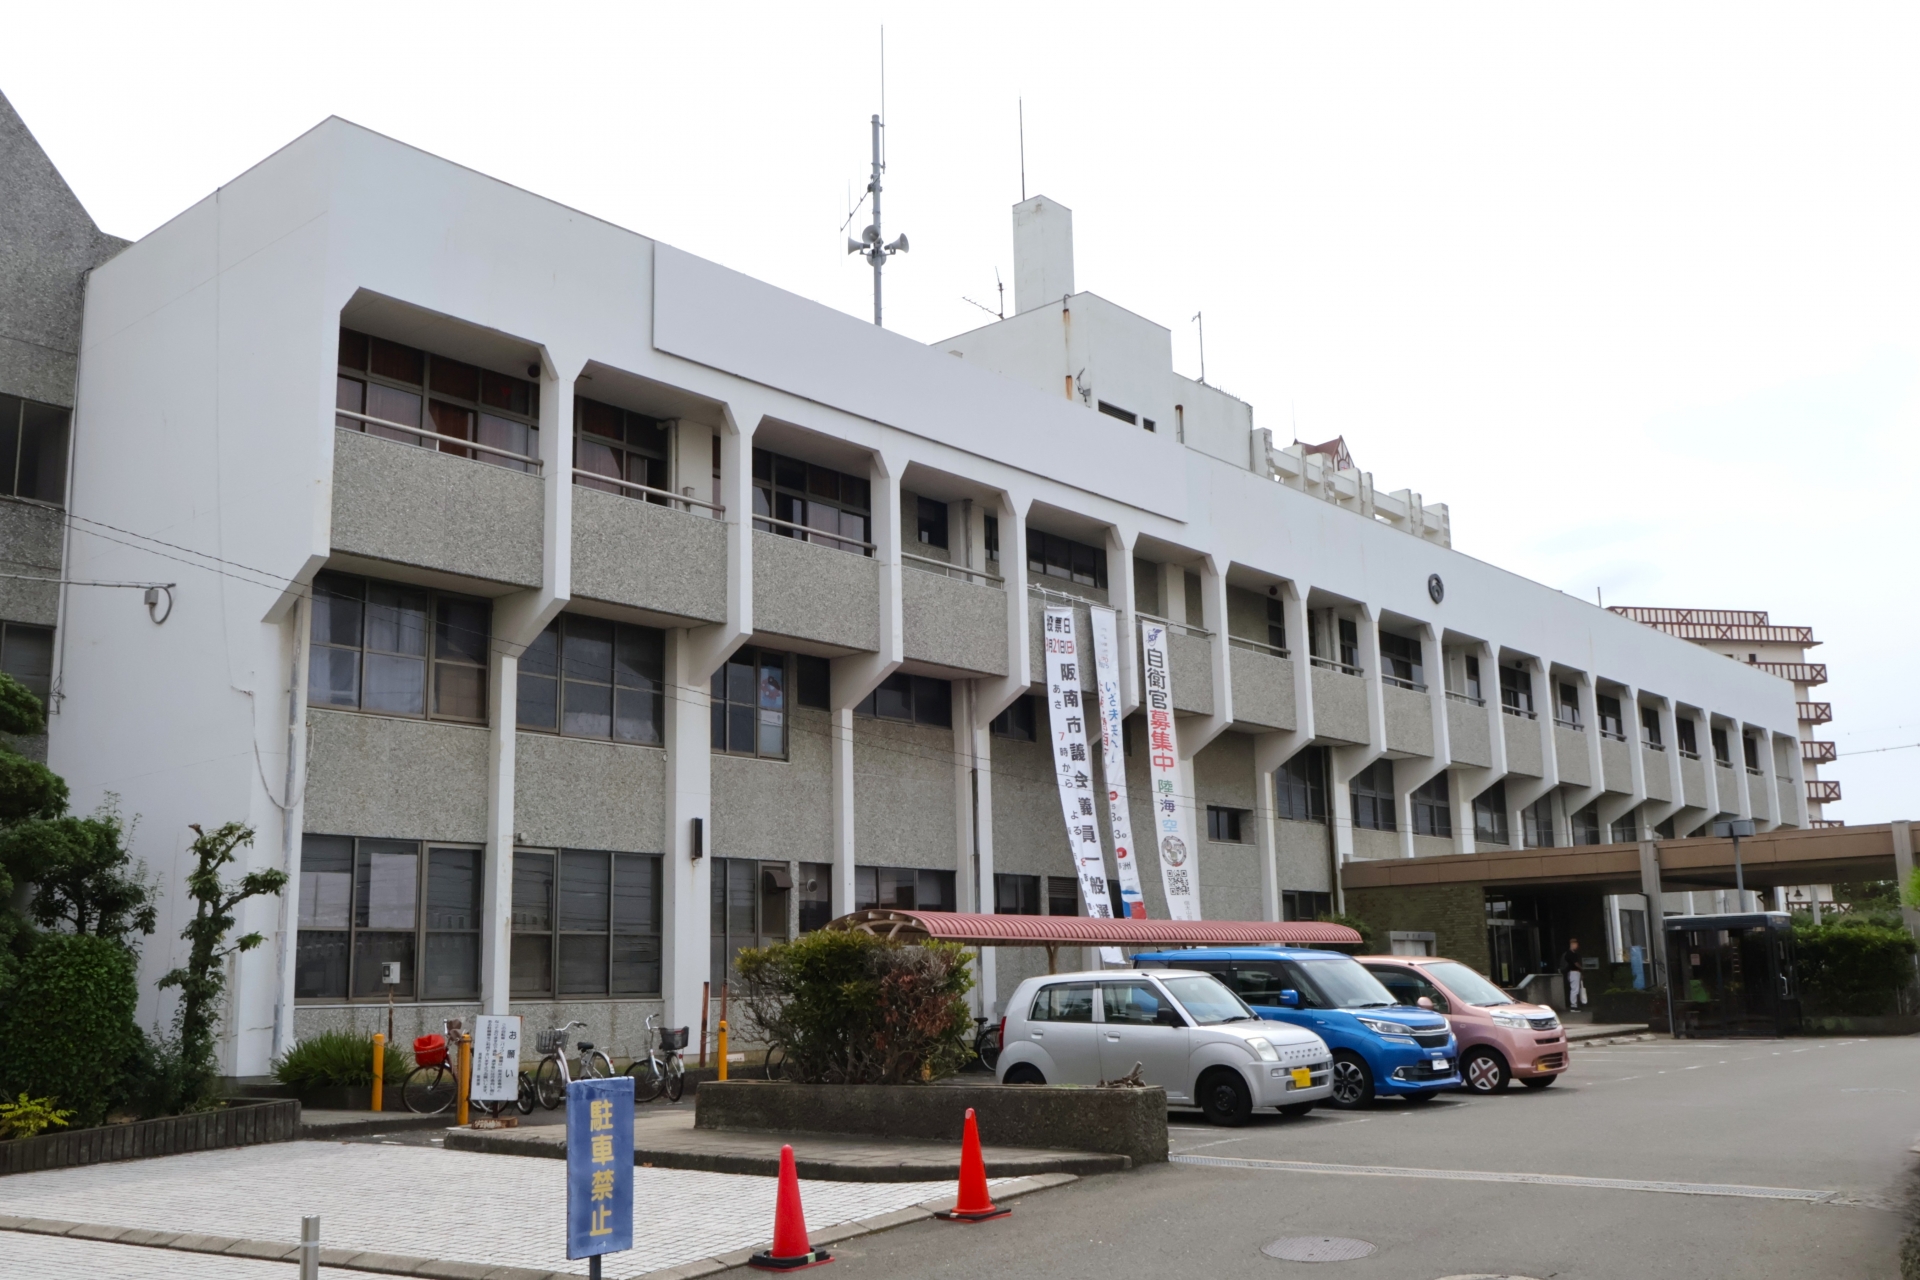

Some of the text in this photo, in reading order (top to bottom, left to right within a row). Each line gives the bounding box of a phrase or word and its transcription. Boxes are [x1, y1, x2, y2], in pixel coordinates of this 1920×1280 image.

[1146, 647, 1175, 773] 自衛官募集中
[505, 1030, 517, 1078] お願い
[589, 1099, 614, 1237] 駐車禁止
